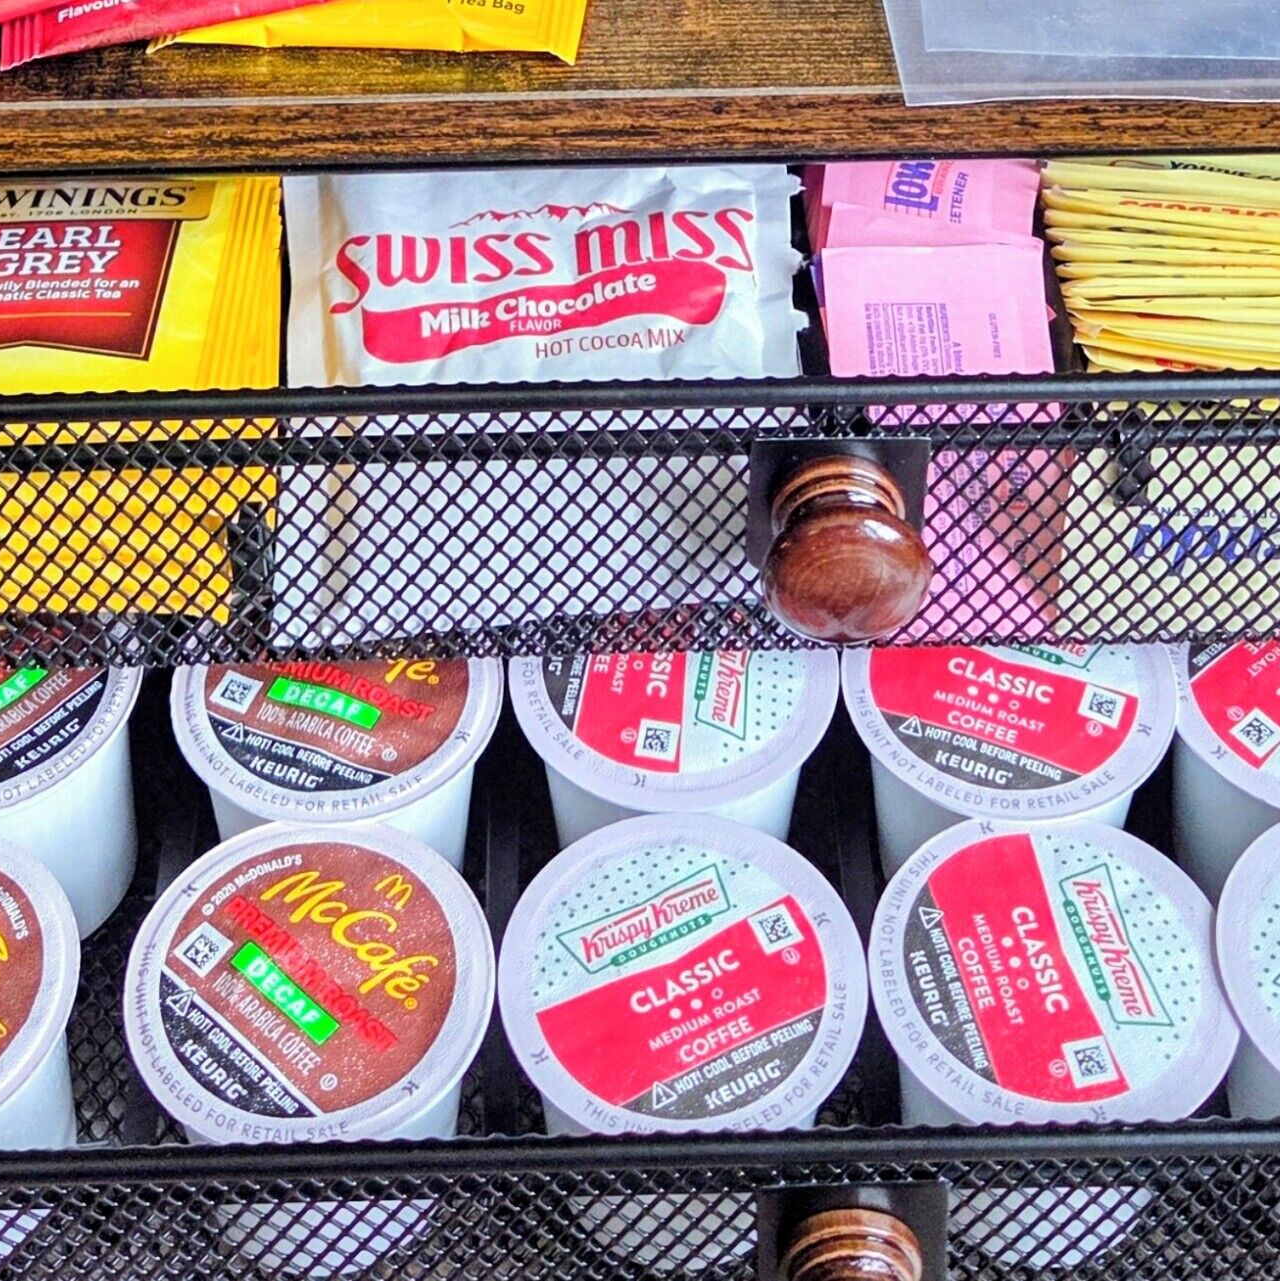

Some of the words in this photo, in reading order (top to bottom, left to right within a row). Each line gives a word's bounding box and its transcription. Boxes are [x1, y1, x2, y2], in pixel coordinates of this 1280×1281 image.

[69, 207, 137, 216] LONDON
[25, 278, 91, 290] Blended
[94, 277, 118, 288] for
[120, 279, 139, 289] an
[35, 289, 91, 300] Classic
[94, 288, 121, 299] Tea
[331, 232, 555, 314] SWISS
[421, 306, 491, 339] Milk
[495, 272, 657, 322] Chocolate
[509, 318, 563, 333] FLAVOR
[536, 339, 573, 359] HOT
[579, 333, 643, 352] COCOA
[647, 329, 685, 349] MIX
[284, 684, 362, 721] DECAF
[352, 677, 435, 722] ROAST
[947, 657, 1054, 704] CLASSIC
[256, 702, 287, 723] 100%
[286, 709, 332, 738] ARABICA
[333, 724, 377, 759] COFFEE
[933, 690, 993, 717] MEDIUM
[997, 710, 1046, 733] ROAST
[947, 711, 1018, 744] COFFEE
[15, 717, 82, 771] KEURIG
[852, 688, 872, 718] THIS
[865, 720, 890, 751] UNIT
[888, 749, 916, 773] NOT
[919, 772, 983, 806] LABELED
[990, 796, 1020, 810] FOR
[1027, 788, 1077, 809] RETAIL
[1082, 771, 1116, 795] SALE
[924, 726, 951, 744] HOT!
[953, 733, 978, 750] COOL
[980, 742, 1018, 765] BEFORE
[1019, 756, 1062, 781] PEELING
[935, 750, 1009, 785] KEURIG
[249, 755, 320, 790] KEURIG
[210, 886, 237, 906] 2020
[235, 854, 303, 893] McDONALD'S
[259, 871, 439, 1001] McCafé
[580, 907, 652, 963] Krispy
[650, 879, 718, 928] Kreme
[618, 915, 709, 961] DOUGHNUTS
[956, 938, 995, 1010] COFFEE
[972, 914, 1003, 973] MEDIUM
[997, 976, 1025, 1025] ROAST
[1011, 907, 1069, 1014] CLASSIC
[1067, 905, 1107, 995] DOUGHNUTS
[1073, 881, 1126, 945] Krispy
[1101, 949, 1156, 1017] Kreme
[246, 955, 322, 1025] DECAF
[629, 949, 740, 1014] CLASSIC
[909, 951, 946, 1026] KEURIG
[648, 1013, 712, 1052] MEDIUM
[712, 988, 761, 1018] ROAST
[677, 1015, 754, 1063] COFFEE
[179, 1039, 246, 1101] KEURIG
[675, 1069, 702, 1096] HOT!
[702, 1058, 733, 1081] COOL
[731, 1037, 770, 1065] BEFORE
[769, 1019, 814, 1047] PEELING
[704, 1062, 779, 1108] KEURIG
